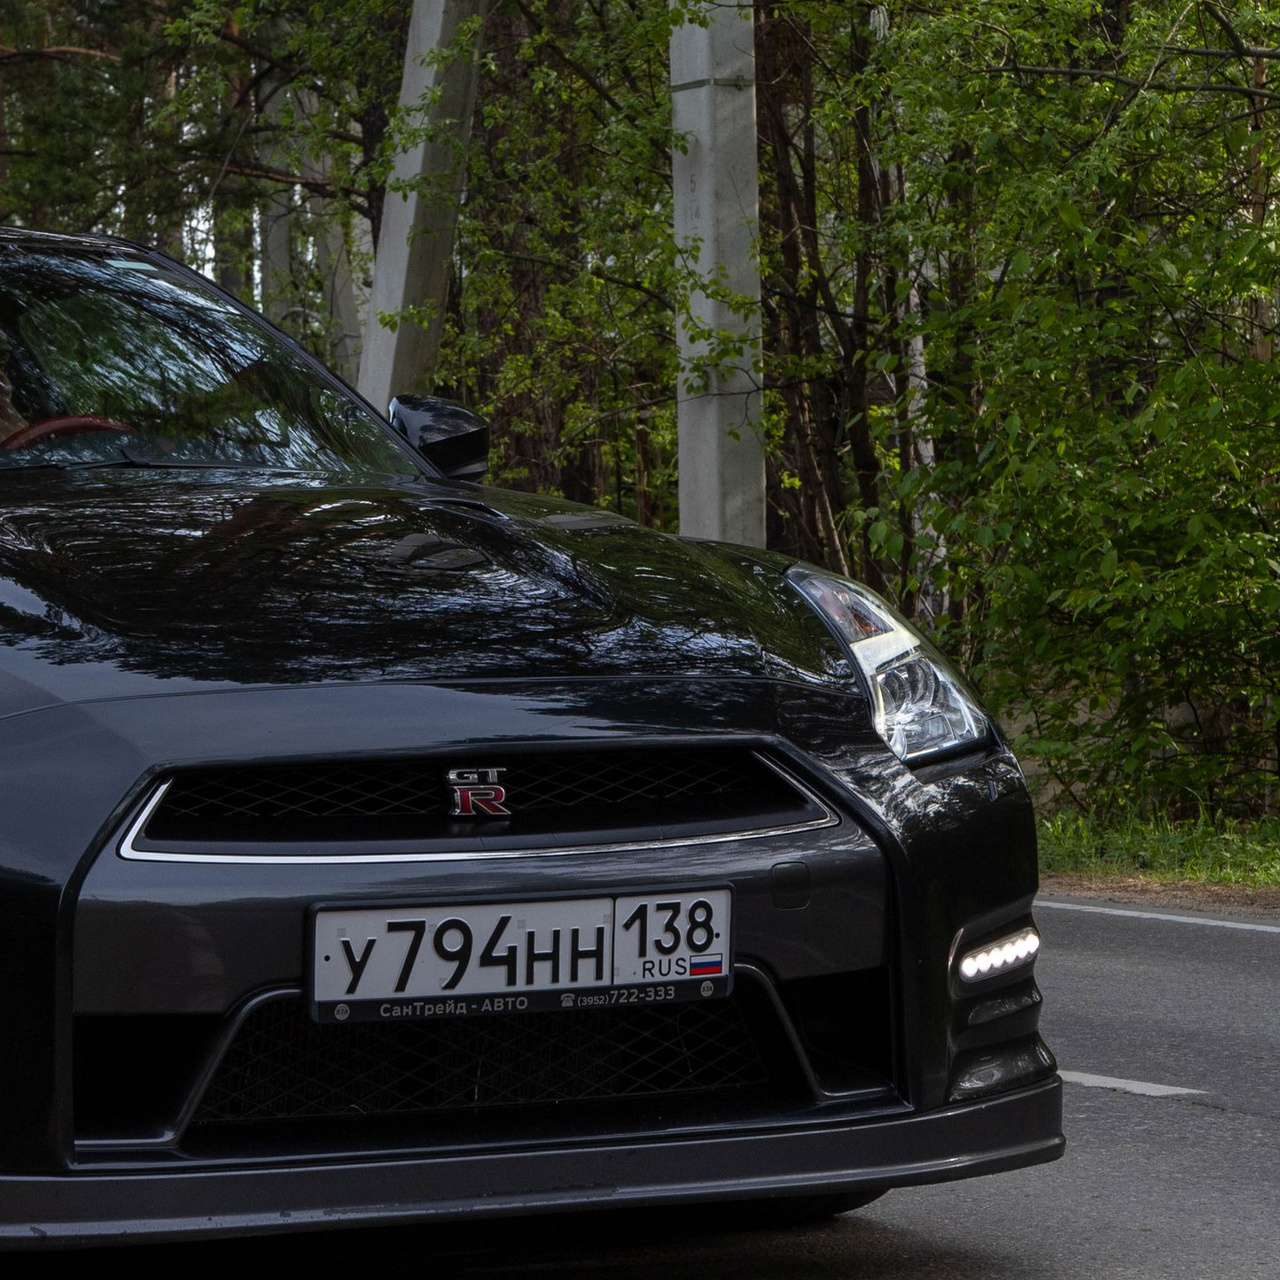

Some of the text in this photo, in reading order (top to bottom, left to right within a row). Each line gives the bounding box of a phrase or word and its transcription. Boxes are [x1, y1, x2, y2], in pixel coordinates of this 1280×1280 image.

[447, 767, 507, 784] GT
[448, 785, 512, 816] R
[622, 898, 714, 959] 138
[642, 957, 688, 979] RUS
[379, 999, 467, 1017] СанТрейд
[480, 996, 529, 1012] АВТО
